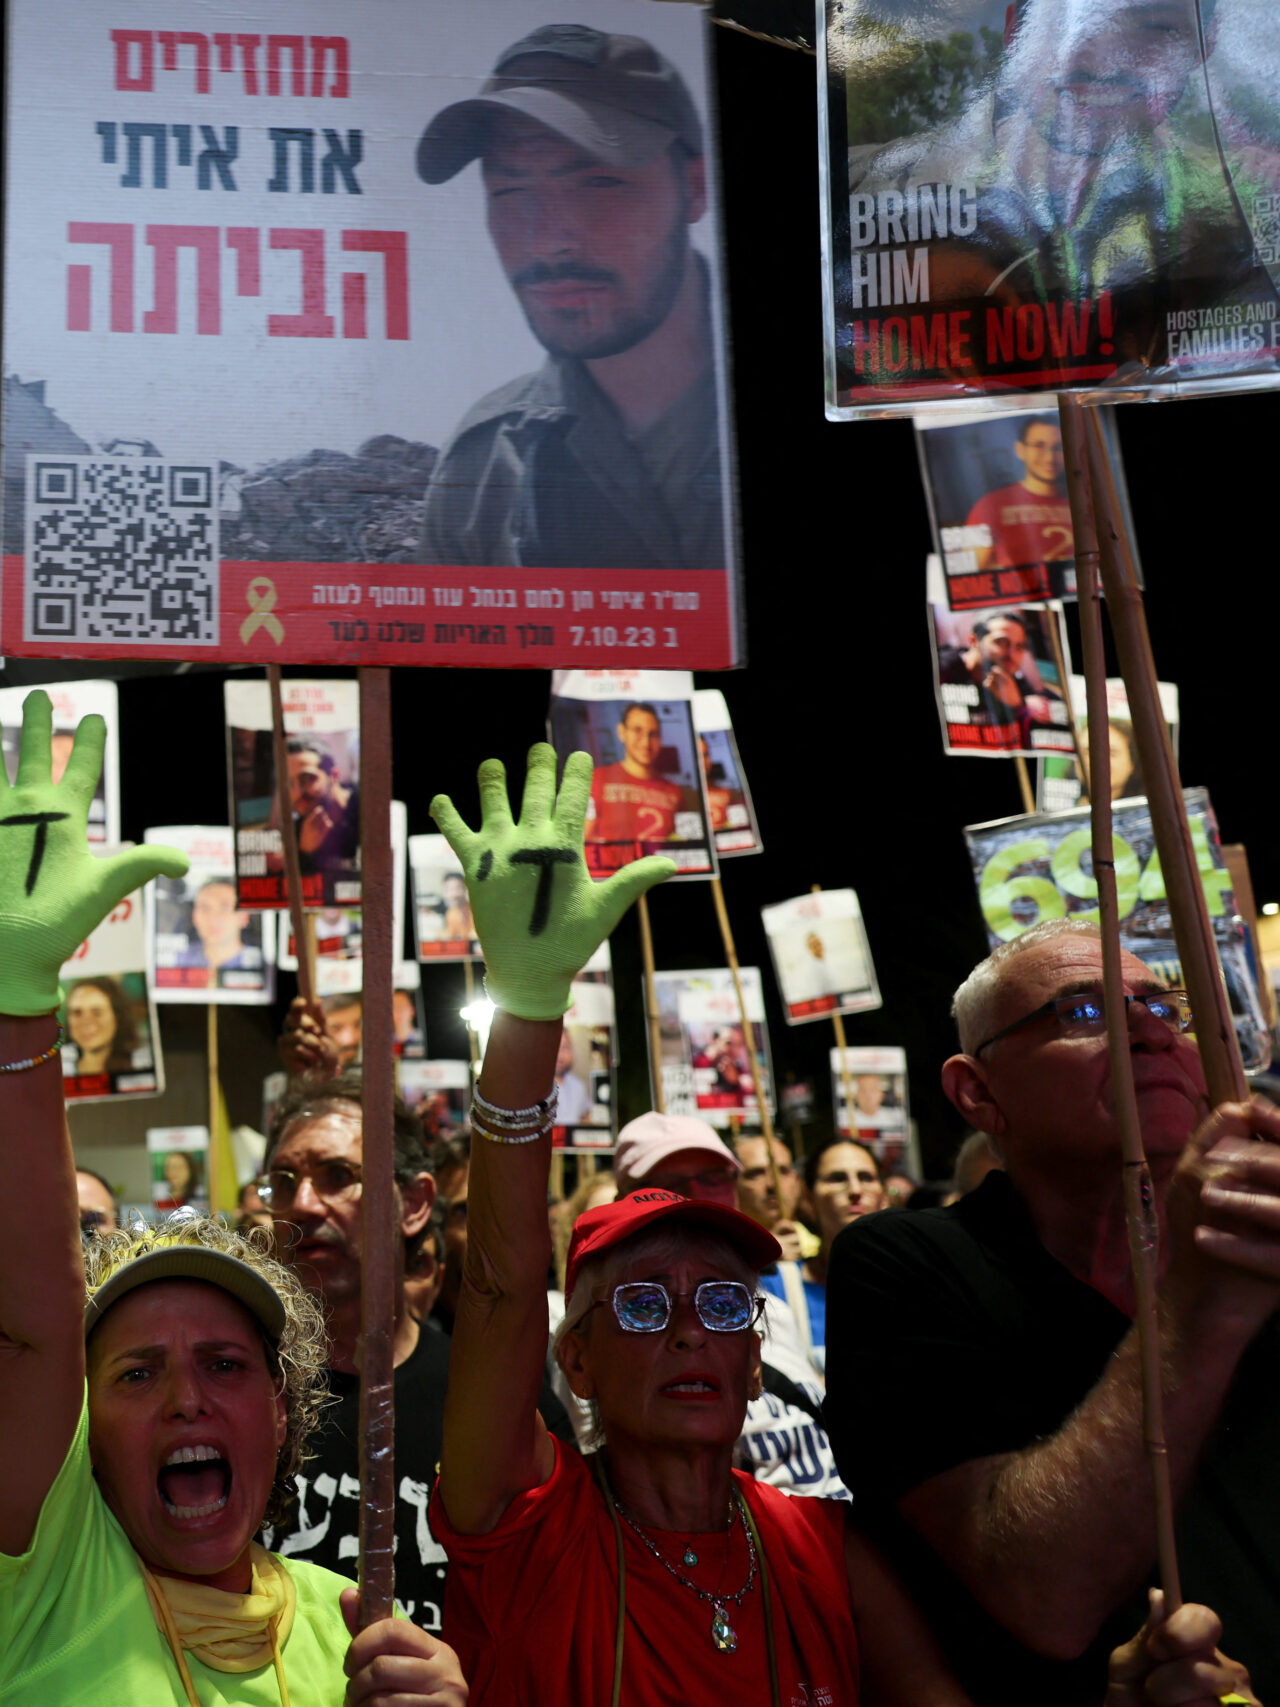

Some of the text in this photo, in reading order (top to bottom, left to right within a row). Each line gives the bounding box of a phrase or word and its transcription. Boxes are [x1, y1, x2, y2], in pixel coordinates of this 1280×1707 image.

[110, 29, 351, 98] מחזירים
[96, 121, 363, 195] את איתי
[849, 182, 977, 248] BRING
[66, 221, 410, 341] הביתה
[851, 247, 930, 309] HIM
[854, 291, 1117, 375] HOME NOW!
[1167, 301, 1276, 331] HOSTAGES AND
[1168, 323, 1264, 360] FAMILIES
[569, 626, 656, 647] 7.10.23
